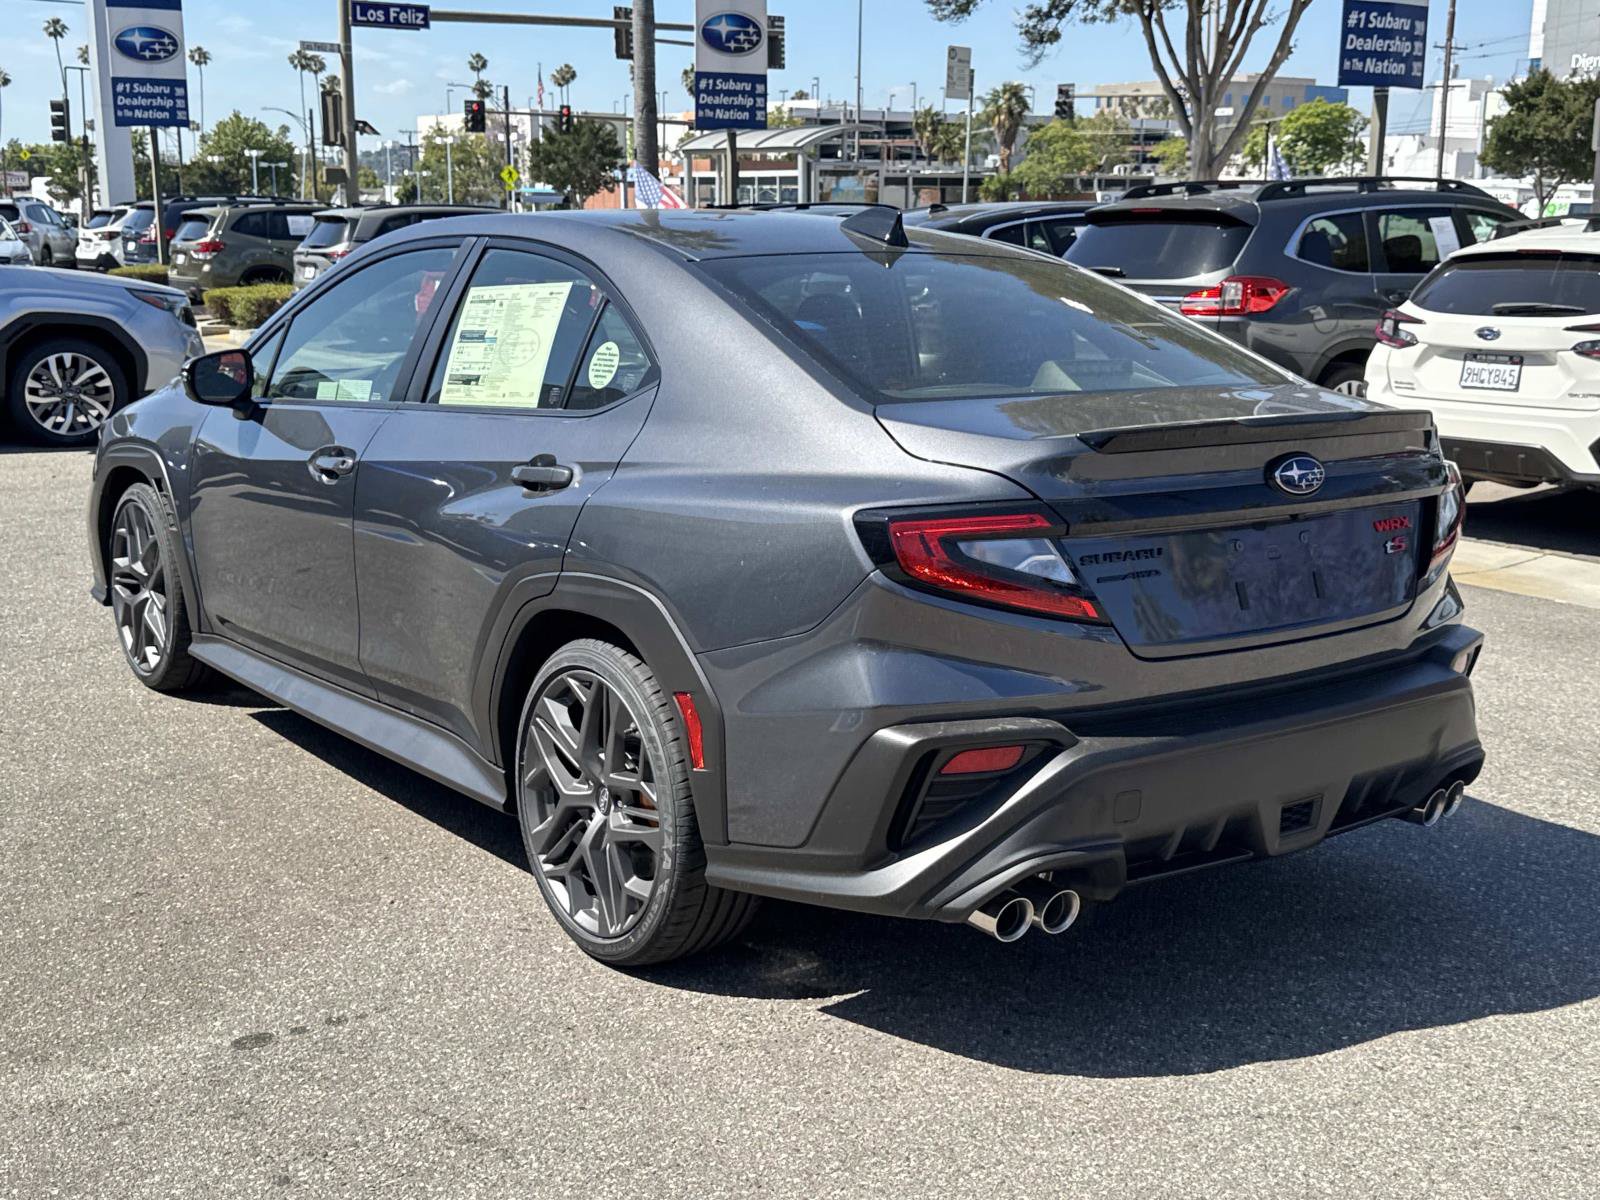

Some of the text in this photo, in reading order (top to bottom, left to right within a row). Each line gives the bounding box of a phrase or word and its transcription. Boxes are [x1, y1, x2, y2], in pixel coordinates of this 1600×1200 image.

[356, 5, 425, 25] Los Feliz
[1347, 10, 1366, 28] #1
[1368, 11, 1412, 30] Subaru
[1345, 33, 1412, 57] Dealership
[1364, 57, 1406, 75] Nation
[116, 82, 130, 93] #1
[132, 83, 170, 94] Subaru
[698, 78, 713, 90] #1
[715, 79, 752, 91] Subaru
[117, 95, 174, 108] Dealership
[698, 93, 754, 108] Dealership
[134, 109, 170, 119] Nation
[715, 108, 750, 120] Nation
[1464, 367, 1516, 386] 9HCY845
[1373, 516, 1412, 533] WRX
[1079, 547, 1163, 566] SUBARU
